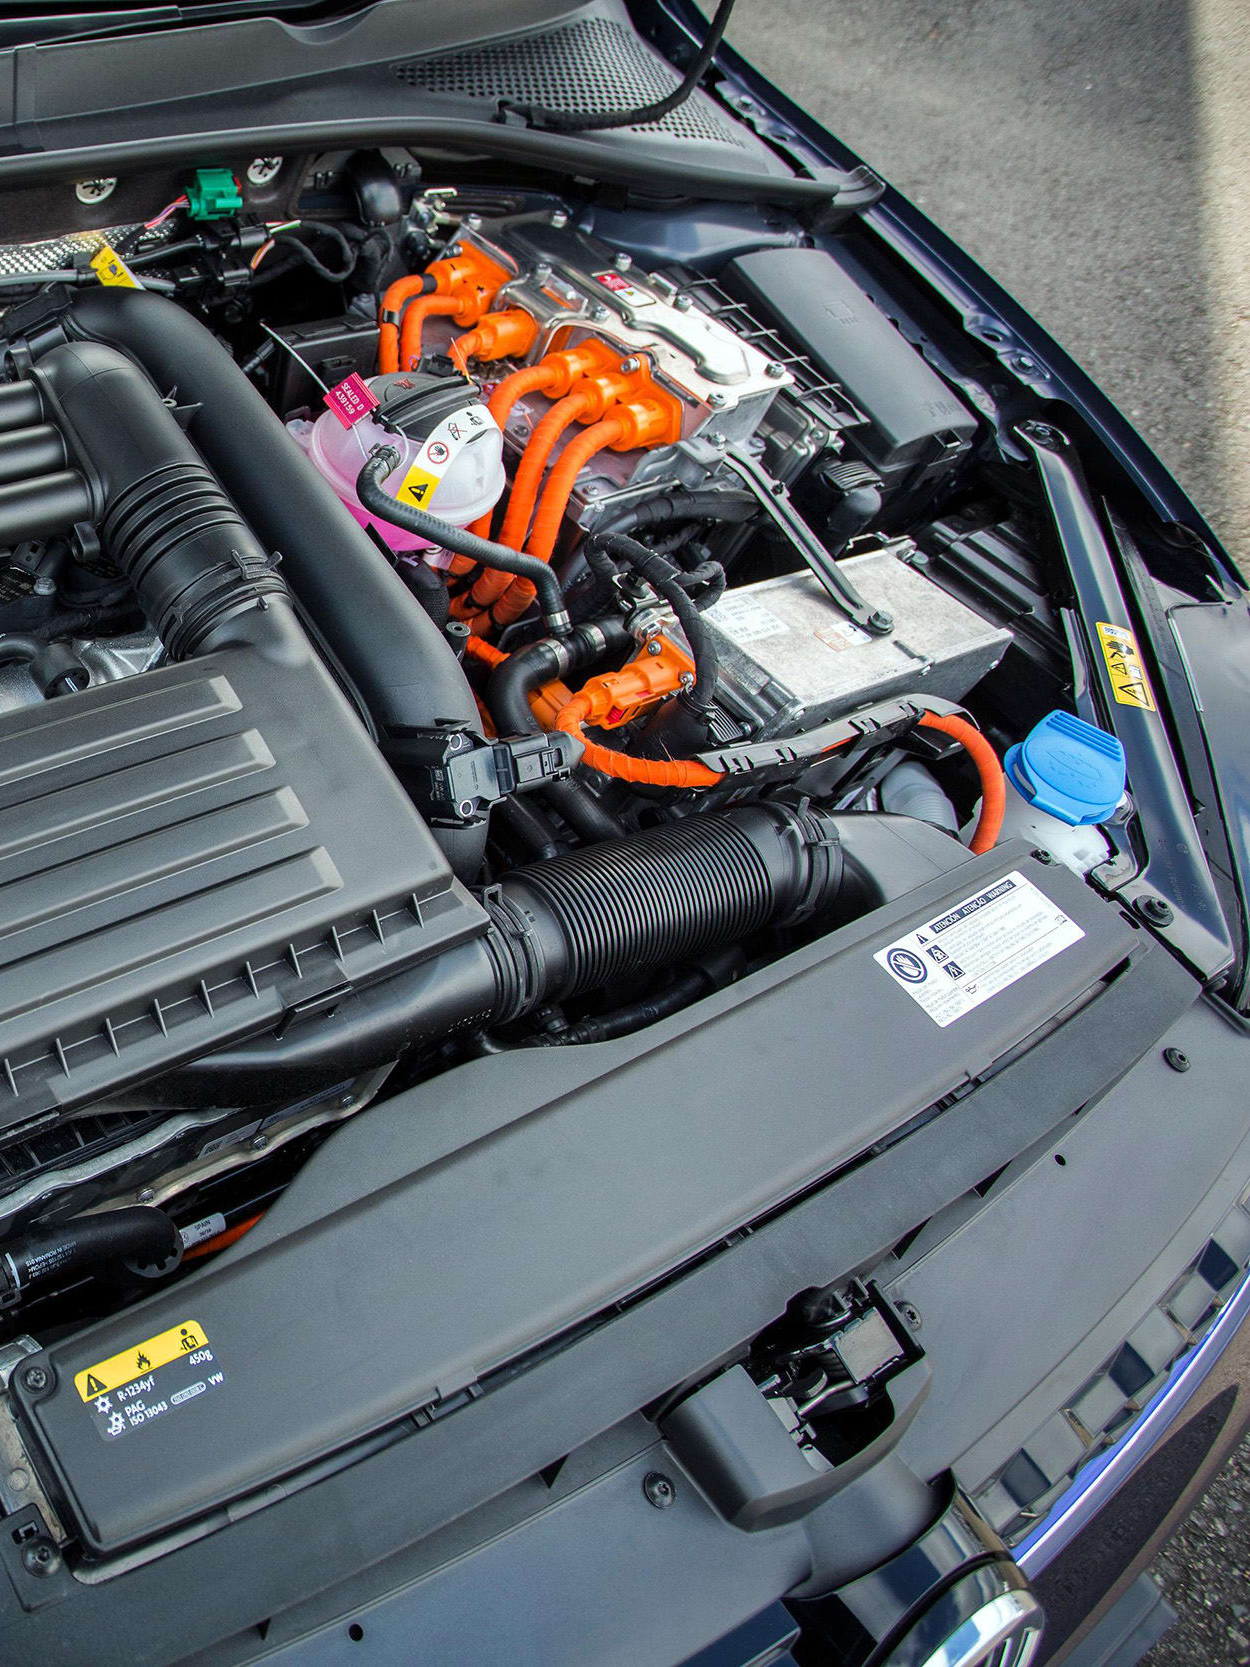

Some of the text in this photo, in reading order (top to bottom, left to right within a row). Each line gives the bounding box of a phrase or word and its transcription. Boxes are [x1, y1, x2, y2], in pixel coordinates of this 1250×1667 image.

[335, 390, 356, 415] 439159
[341, 382, 360, 405] SEALED
[933, 912, 960, 932] ATENCIÓN
[189, 1349, 213, 1368] 450g
[117, 1375, 156, 1403] R-1234yf
[207, 1372, 225, 1386] VW
[124, 1400, 146, 1417] PAG
[129, 1400, 168, 1426] ISO 13043
